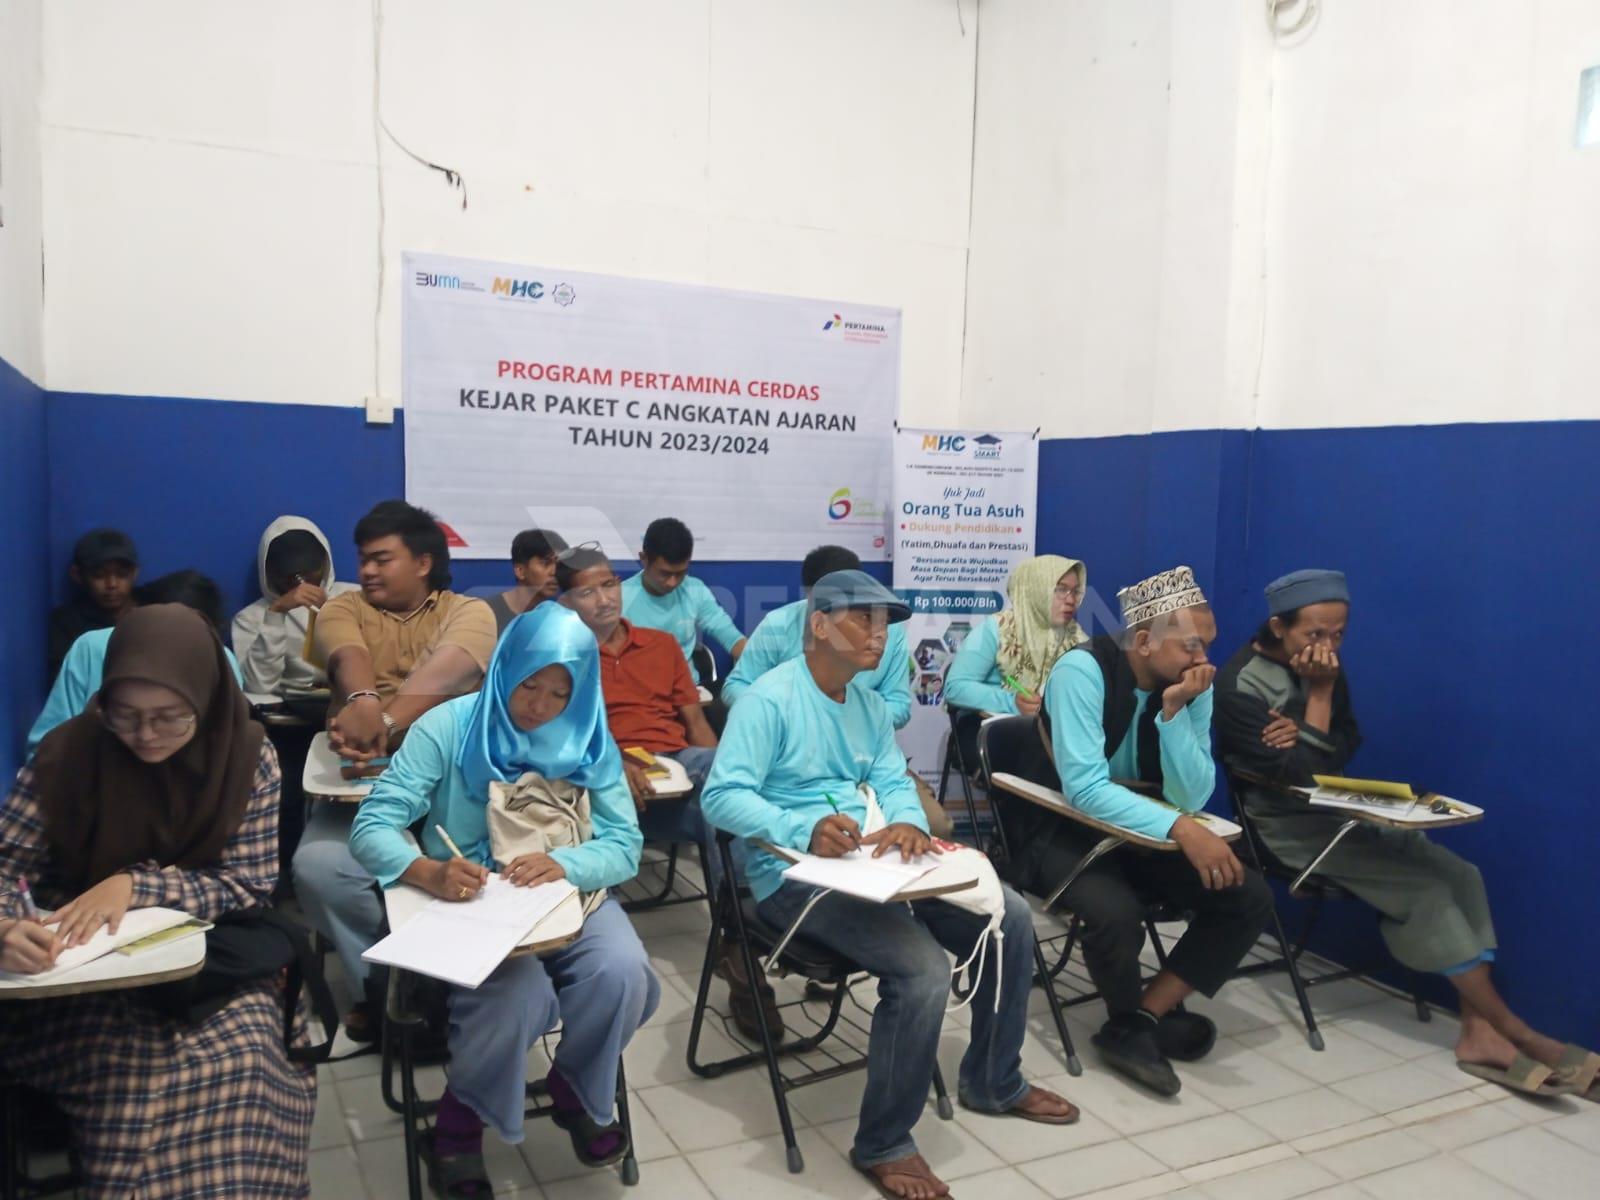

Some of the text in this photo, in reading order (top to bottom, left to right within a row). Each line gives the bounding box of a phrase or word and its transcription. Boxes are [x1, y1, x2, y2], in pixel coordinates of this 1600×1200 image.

[492, 276, 544, 299] MHC
[844, 321, 886, 332] PERTAMINA
[497, 360, 820, 401] PROGRAM PERTAMINA CERDAS
[459, 388, 856, 432] KEJAR PAKET C ANGKATAN AJARAN
[569, 426, 769, 455] TAHUN 2023/2024
[922, 433, 966, 452] MHC
[902, 502, 1025, 519] Orang Tua Asuh
[909, 522, 1014, 535] Dukung Pendidikan
[968, 541, 986, 550] dan
[988, 542, 1029, 552] Prestasi)
[914, 596, 930, 610] Rp
[931, 596, 997, 609] 100.000/Bln
